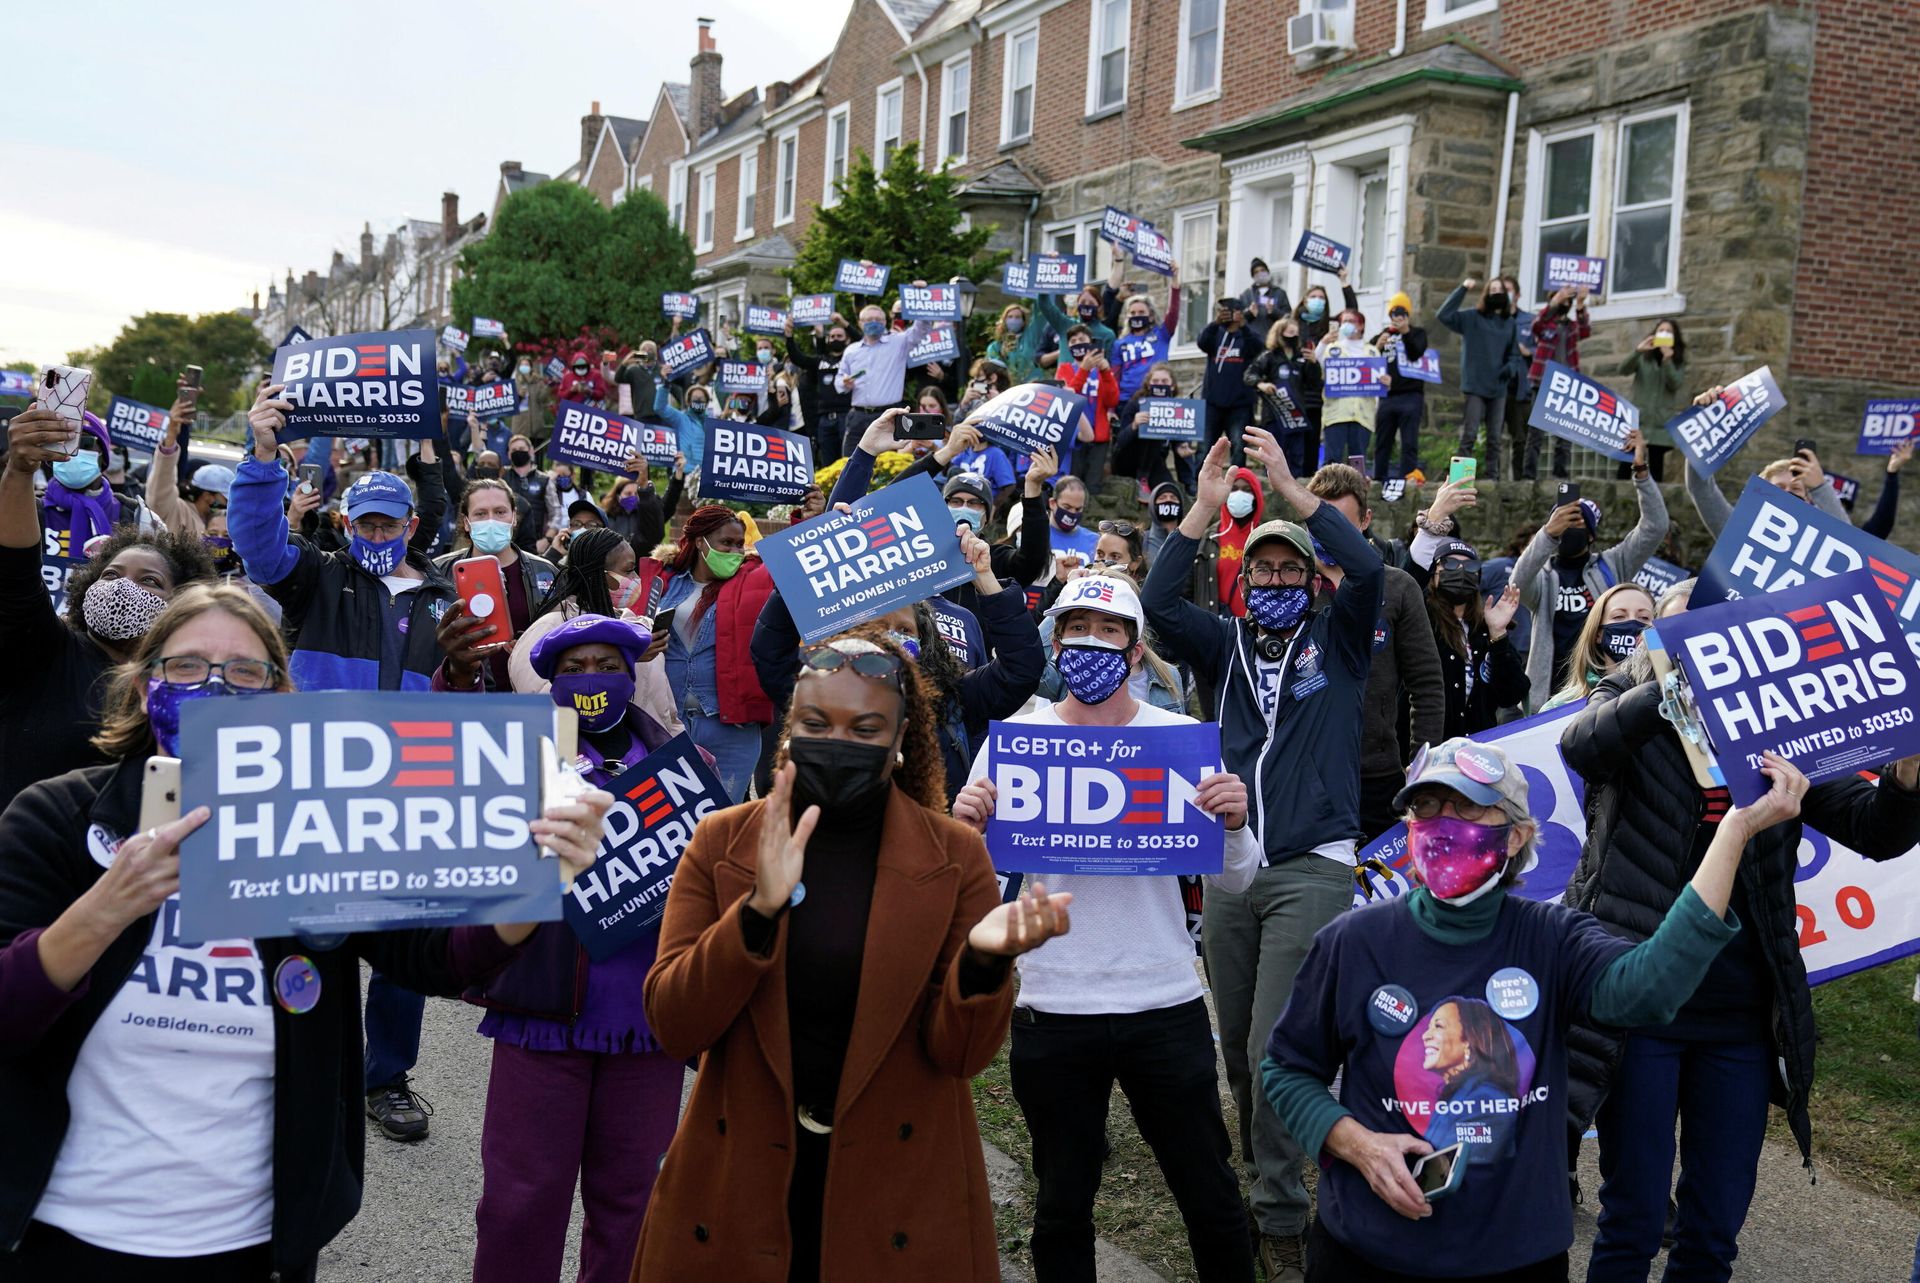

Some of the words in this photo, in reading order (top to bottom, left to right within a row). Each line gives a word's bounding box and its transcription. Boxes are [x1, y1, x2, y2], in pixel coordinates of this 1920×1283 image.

[1306, 239, 1343, 260] BIDEN
[842, 263, 886, 279] BIDEN
[1037, 263, 1077, 274] BIDEN
[1550, 257, 1602, 273] BIDEN
[840, 275, 882, 288] HARRIS
[1036, 274, 1077, 283] HARRIS
[1549, 270, 1601, 285] HARRIS
[663, 294, 697, 307] BIDEN
[794, 297, 831, 311] BIDEN
[903, 288, 955, 301] BIDEN
[663, 303, 696, 314] HARRIS
[749, 308, 787, 322] BIDEN
[792, 307, 831, 319] HARRIS
[905, 300, 956, 311] HARRIS
[662, 332, 704, 361] BIDEN
[665, 343, 708, 368] HARRIS
[283, 343, 421, 382] BIDEN
[723, 363, 767, 377] BIDEN
[723, 374, 765, 385] HARRIS
[1326, 367, 1386, 385] BIDEN
[279, 380, 425, 407] HARRIS
[475, 383, 513, 402] BIDEN
[1550, 371, 1632, 426] BIDEN
[475, 396, 515, 411] HARRIS
[1012, 390, 1074, 424] DEN
[1150, 406, 1195, 419] BIDEN
[1677, 374, 1763, 443] BIDEN
[289, 414, 312, 424] Text
[314, 413, 363, 424] UNITED
[367, 415, 377, 424] to
[379, 413, 421, 423] 30330
[990, 405, 1064, 443] ARRIS
[1149, 418, 1195, 428] HARRIS
[1544, 391, 1633, 439] HARRIS
[1691, 385, 1769, 458] HARRIS
[110, 416, 167, 442] HARRI
[564, 408, 638, 445] BIDEN
[643, 428, 677, 445] DEN
[986, 421, 1018, 439] UNITED
[1018, 435, 1024, 443] to
[1545, 413, 1558, 424] Text
[1558, 418, 1591, 436] UNITED
[1590, 432, 1597, 440] to
[1598, 434, 1624, 450] 30330
[1718, 428, 1743, 453] UNITED
[1747, 402, 1771, 422] 30330
[560, 428, 636, 460] HARRIS
[641, 443, 677, 456] ARRIS
[714, 428, 805, 464] BIDEN
[559, 447, 573, 456] Text
[573, 450, 600, 462] UNITED
[607, 459, 626, 469] 3033
[712, 455, 809, 485] HARRIS
[714, 480, 730, 488] Text
[731, 481, 766, 492] UNITED
[777, 486, 804, 496] 30330
[1158, 504, 1179, 516] VOTE
[788, 515, 854, 547] WOMEN
[857, 506, 874, 523] for
[795, 505, 924, 575] BIDEN
[362, 545, 393, 565] VOTE
[361, 559, 393, 576] BLUE
[809, 534, 935, 599] HARRIS
[817, 603, 841, 618] Text
[841, 580, 894, 608] WOMEN
[897, 577, 907, 588] to
[908, 560, 948, 583] 30330
[1072, 587, 1114, 603] JOE
[1078, 581, 1114, 591] TEAM
[1257, 599, 1277, 614] vote
[1271, 600, 1292, 619] vote
[1292, 593, 1308, 614] vote
[936, 612, 964, 628] 2020
[1684, 594, 1886, 691] BIDEN
[1294, 643, 1317, 666] BIDEN
[1296, 649, 1319, 670] HARRIS
[1083, 671, 1108, 693] vote
[573, 691, 609, 711] VOTE
[1712, 651, 1907, 742] HARRIS
[1778, 728, 1846, 759] UNITED
[1848, 724, 1863, 740] to
[1862, 707, 1914, 735] 30330
[217, 721, 526, 795] BIDEN
[997, 735, 1103, 758] LGBTQ+
[1106, 739, 1142, 763] for
[996, 763, 1216, 825] BIDEN
[597, 756, 706, 859] DEN
[218, 795, 531, 861] HARRIS
[1011, 833, 1045, 847] Text
[1050, 834, 1111, 849] PRIDE
[1117, 836, 1133, 849] to
[1137, 834, 1199, 849] 30330
[229, 878, 281, 900] Text
[286, 869, 400, 895] UNITED
[406, 871, 428, 889] to
[434, 865, 519, 888] 30330
[599, 907, 625, 931] Text
[1492, 976, 1529, 989] here's
[1502, 987, 1523, 998] the
[1374, 999, 1409, 1024] HARRIS
[1377, 990, 1413, 1017] BIDEN
[1501, 997, 1528, 1009] deal
[121, 1012, 254, 1036] JoeBiden.com
[1435, 1100, 1476, 1115] GOT
[1481, 1098, 1520, 1114] HER
[1456, 1126, 1492, 1137] BIDEN
[1457, 1135, 1492, 1144] HARRIS
